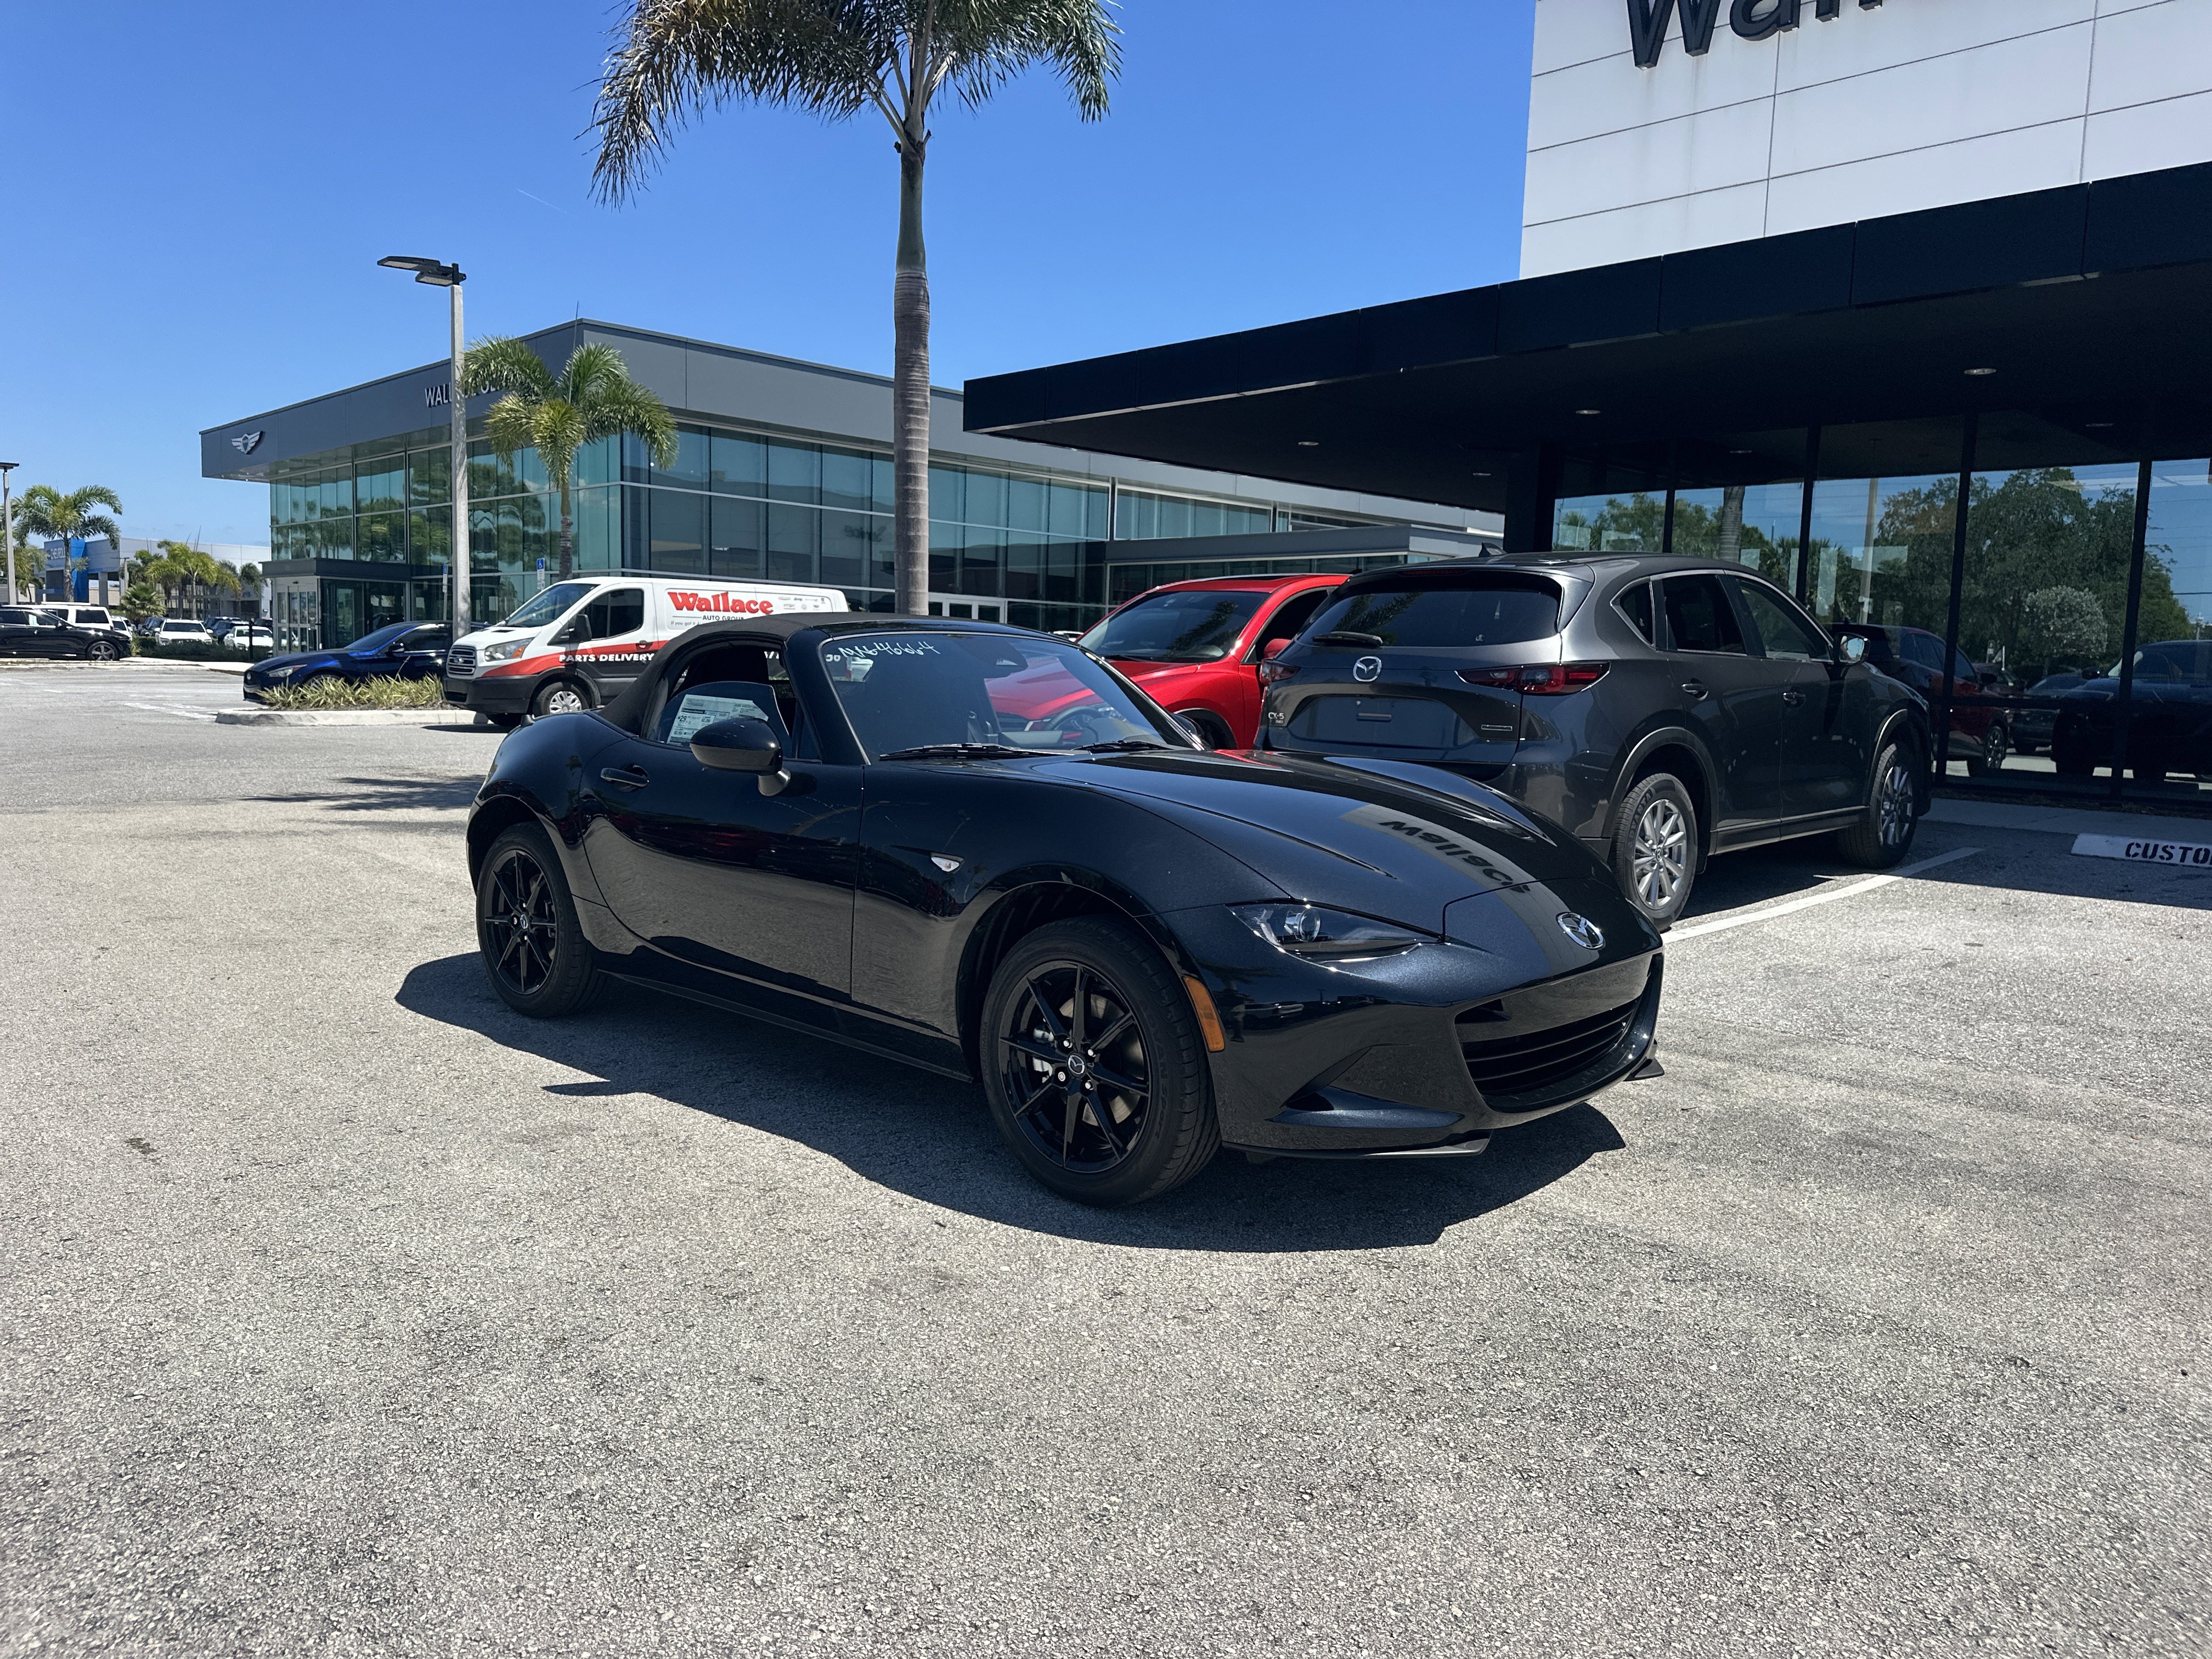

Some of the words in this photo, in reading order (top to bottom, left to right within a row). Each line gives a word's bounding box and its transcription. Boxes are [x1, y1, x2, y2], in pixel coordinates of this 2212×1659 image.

[667, 591, 774, 615] Wallace
[558, 654, 596, 663] PARTS
[599, 653, 654, 662] DELIVERY
[1268, 712, 1285, 720] CX-5
[2125, 842, 2212, 865] CUSTO
